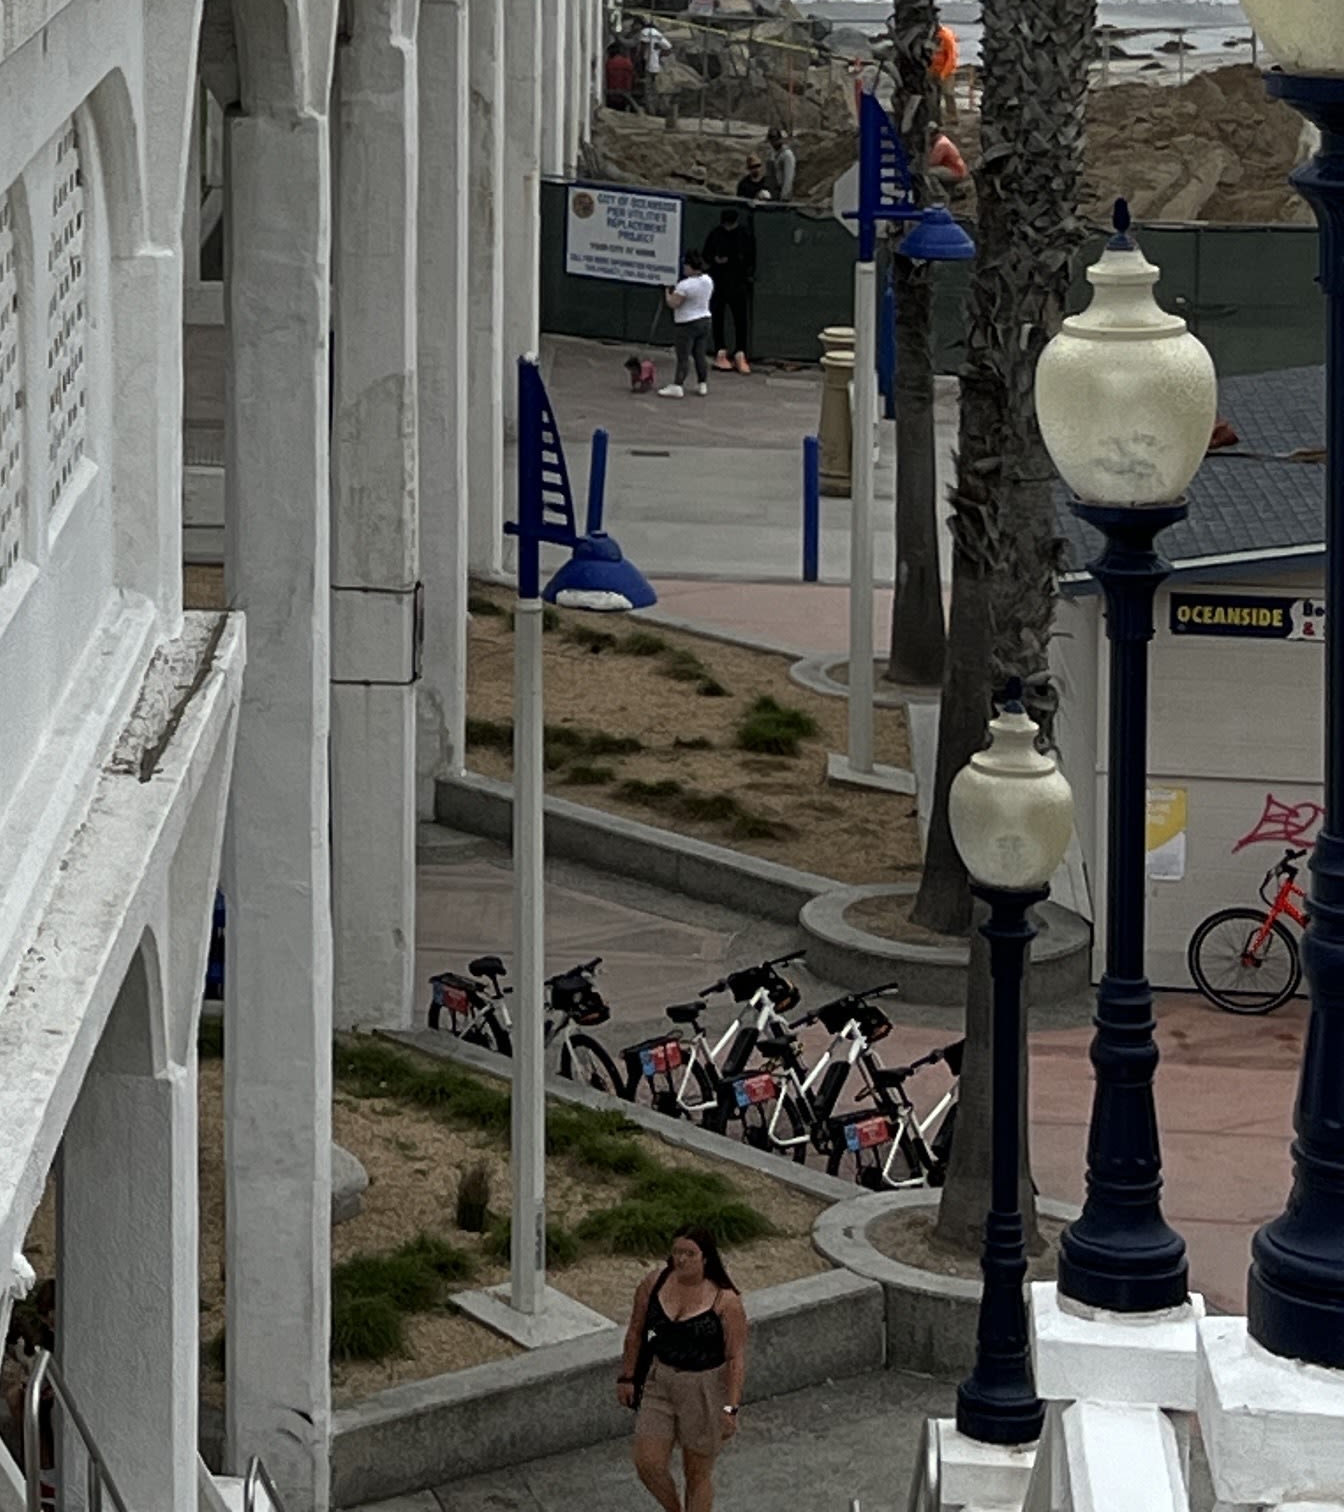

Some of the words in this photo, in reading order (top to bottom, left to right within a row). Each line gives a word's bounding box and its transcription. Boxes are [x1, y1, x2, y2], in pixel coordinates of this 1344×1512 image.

[597, 193, 616, 205] CITY
[617, 196, 629, 206] OF
[631, 197, 677, 213] OCEANSIDE
[607, 217, 666, 234] REPLACEMENT
[618, 229, 654, 243] PROJECT
[1176, 605, 1284, 628] OCEANSIDE
